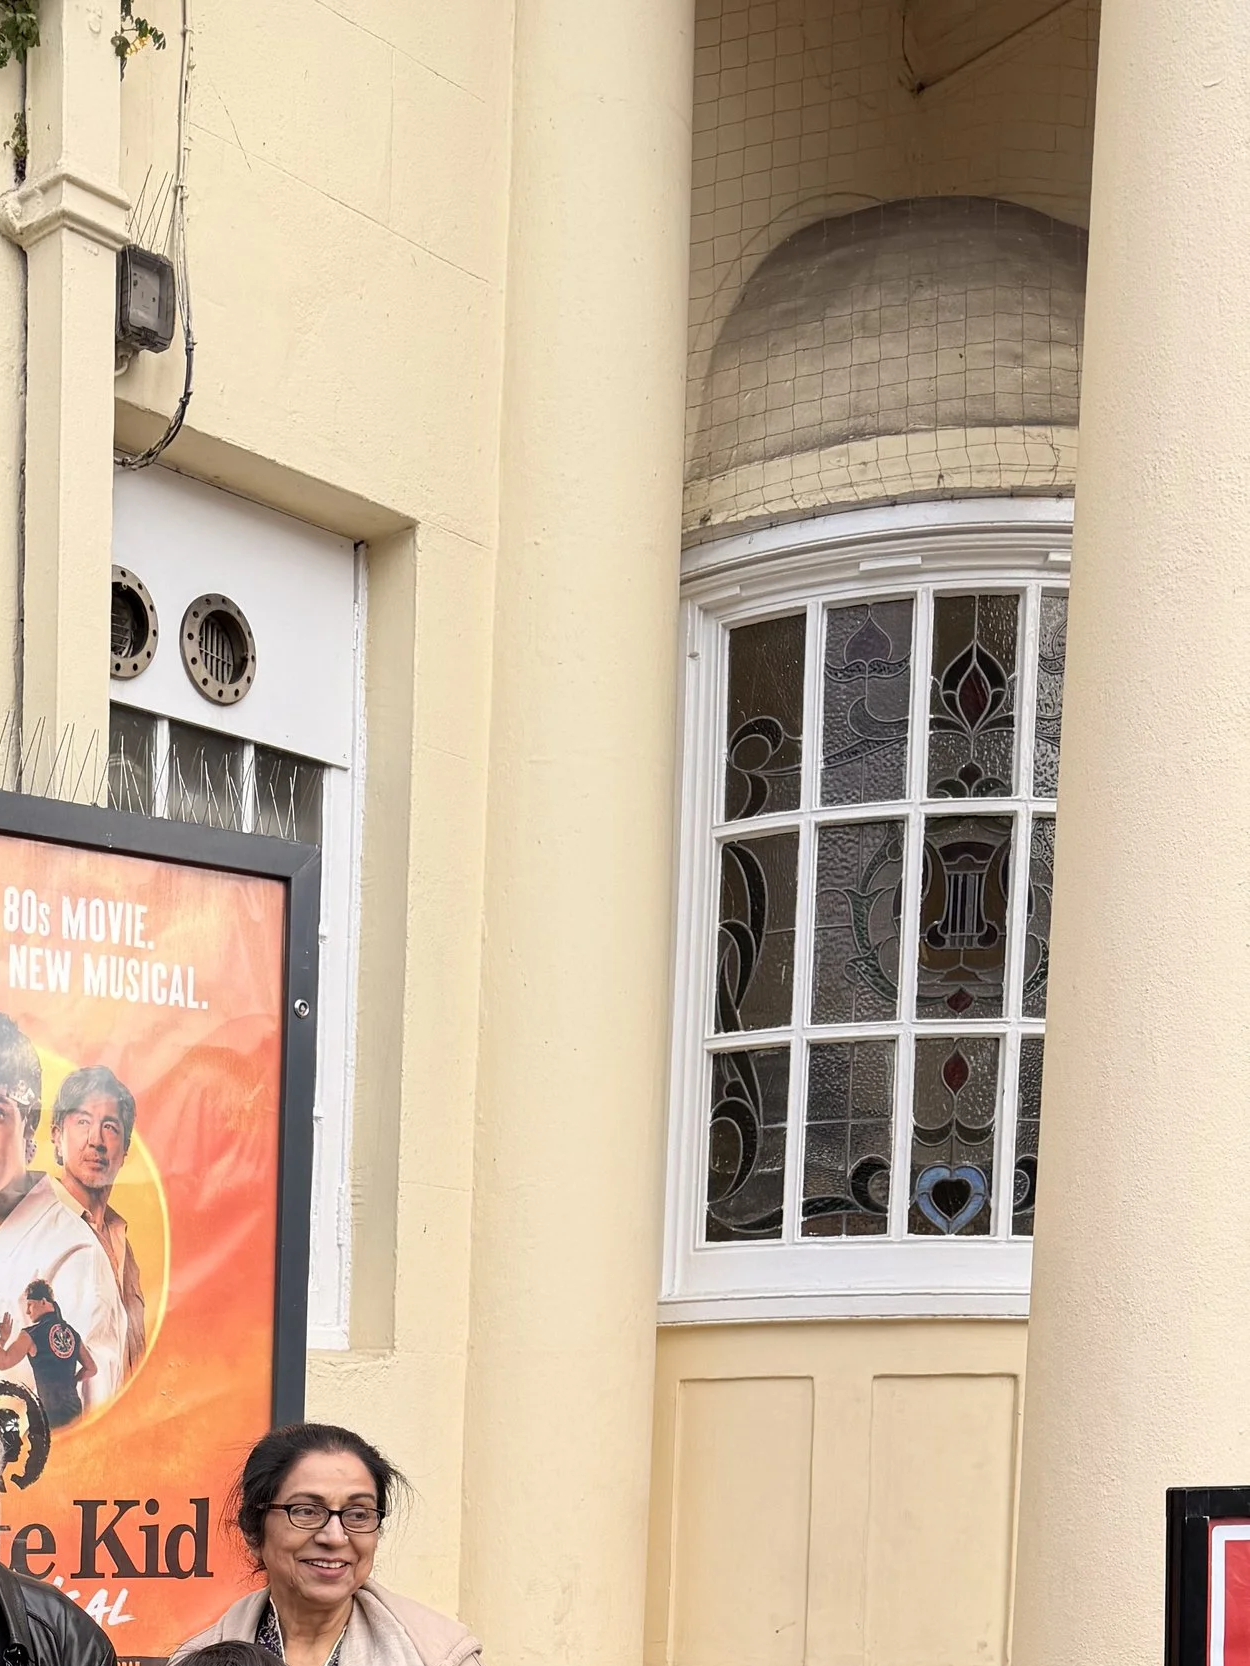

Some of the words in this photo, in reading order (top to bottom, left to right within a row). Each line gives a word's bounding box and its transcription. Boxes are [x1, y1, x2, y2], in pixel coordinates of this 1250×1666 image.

[3, 886, 51, 937] 80s
[61, 895, 155, 950] MOVIE.
[8, 944, 72, 995] NEW
[82, 953, 209, 1010] MUSICAL.
[70, 1496, 215, 1580] Kid
